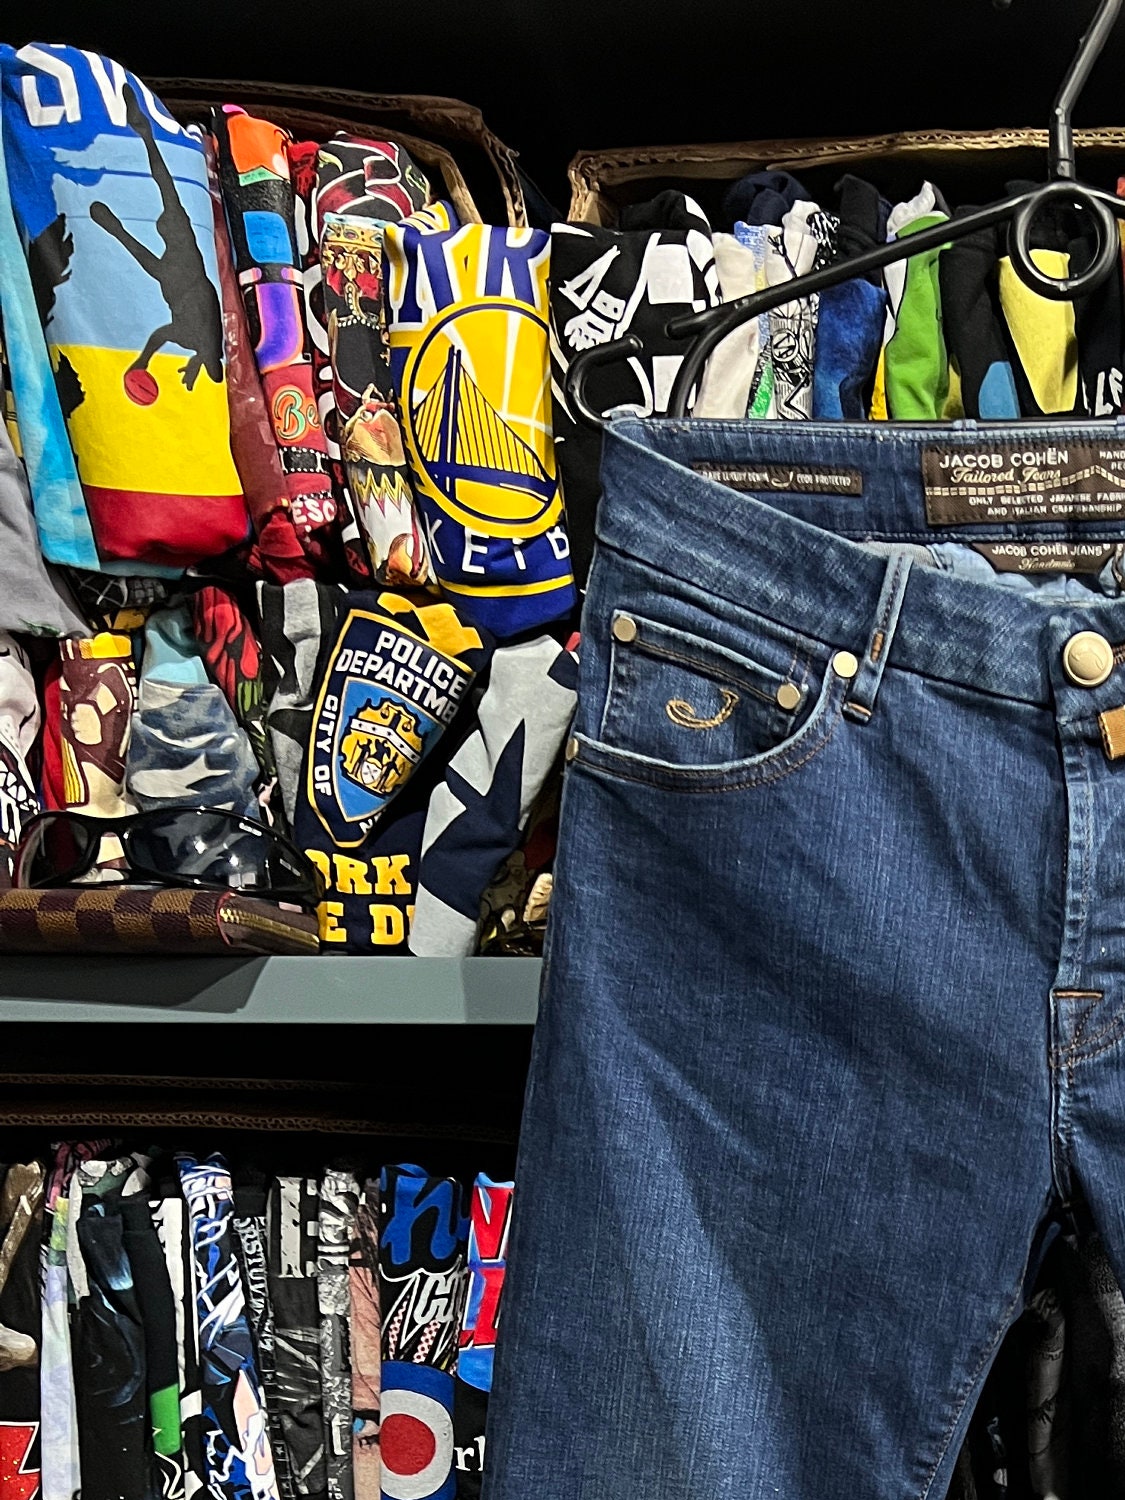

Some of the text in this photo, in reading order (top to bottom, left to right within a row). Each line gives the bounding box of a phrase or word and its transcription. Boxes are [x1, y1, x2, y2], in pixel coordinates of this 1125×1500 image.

[939, 453, 1004, 469] JACOB
[951, 467, 1061, 486] Tailored Jeans
[968, 496, 993, 507] ONLY
[987, 507, 1008, 517] AND
[991, 544, 1028, 557] JACOB
[374, 630, 468, 699] POLICE
[313, 694, 339, 797] CITY OF
